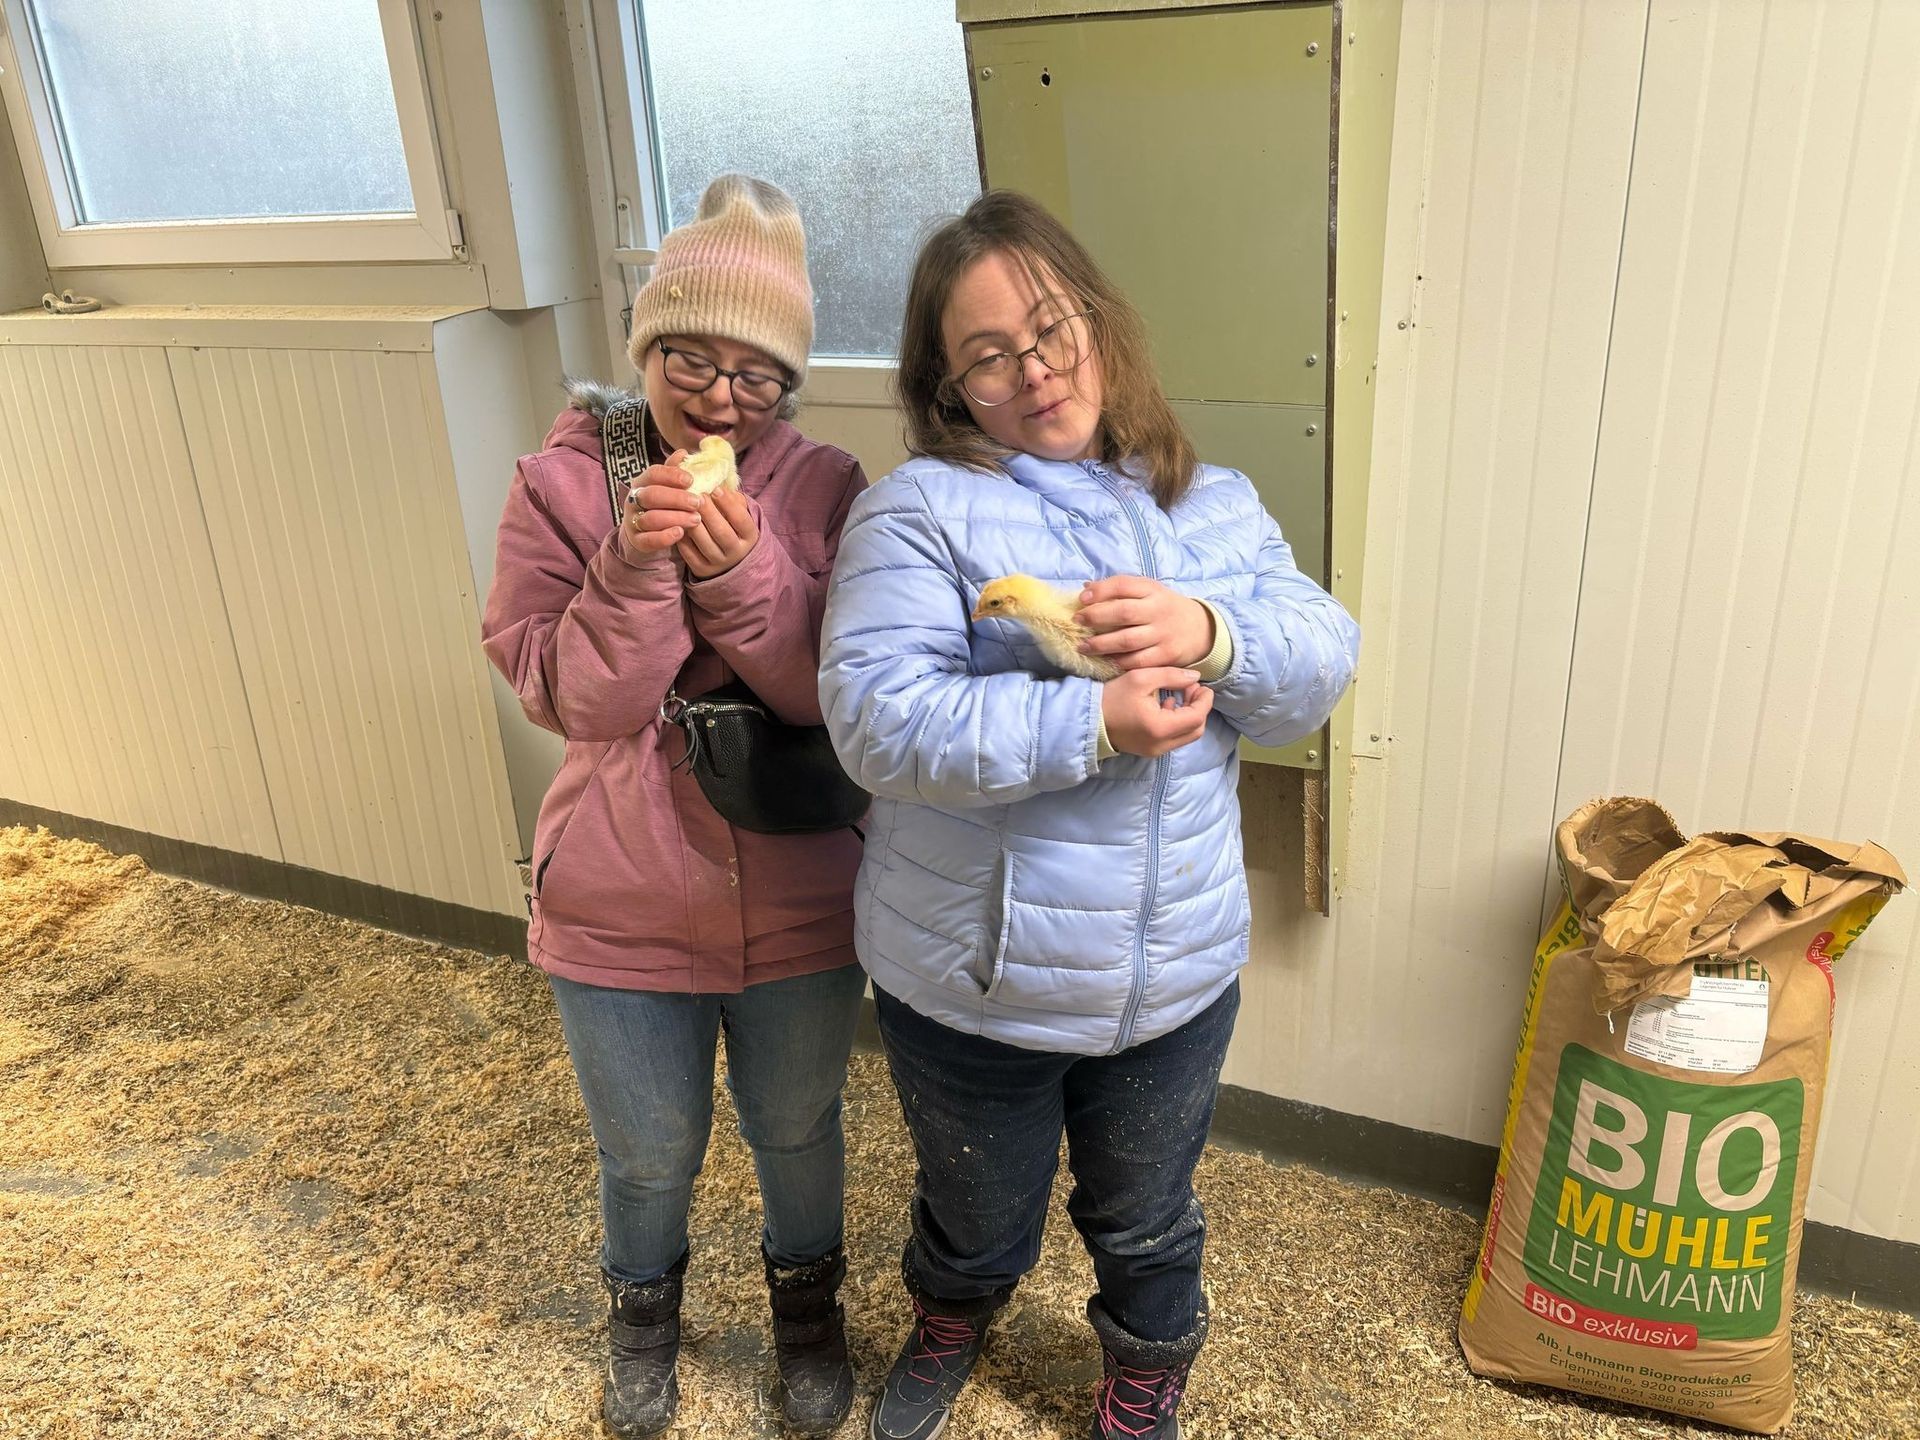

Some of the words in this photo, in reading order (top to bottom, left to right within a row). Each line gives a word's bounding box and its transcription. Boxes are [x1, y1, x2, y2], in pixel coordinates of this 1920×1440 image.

[1567, 1078, 1781, 1211] BIO
[1556, 1176, 1772, 1269] MÜHLE
[1548, 1230, 1765, 1313] LEHMANN
[1532, 1291, 1576, 1324] BIO
[1583, 1318, 1688, 1346] exklusiv
[1536, 1332, 1562, 1352] Alb.
[1567, 1345, 1635, 1373] Lehmann
[1639, 1366, 1729, 1388] Bioprodukte
[1731, 1374, 1752, 1386] AG
[1550, 1354, 1635, 1386] Erlenmühle,
[1641, 1379, 1676, 1393] 9200
[1681, 1386, 1733, 1399] Gossau
[1566, 1373, 1616, 1392] Telefon
[1621, 1387, 1643, 1397] 071
[1649, 1392, 1674, 1404] 388
[1678, 1397, 1694, 1407] 08
[1698, 1400, 1714, 1410] 70
